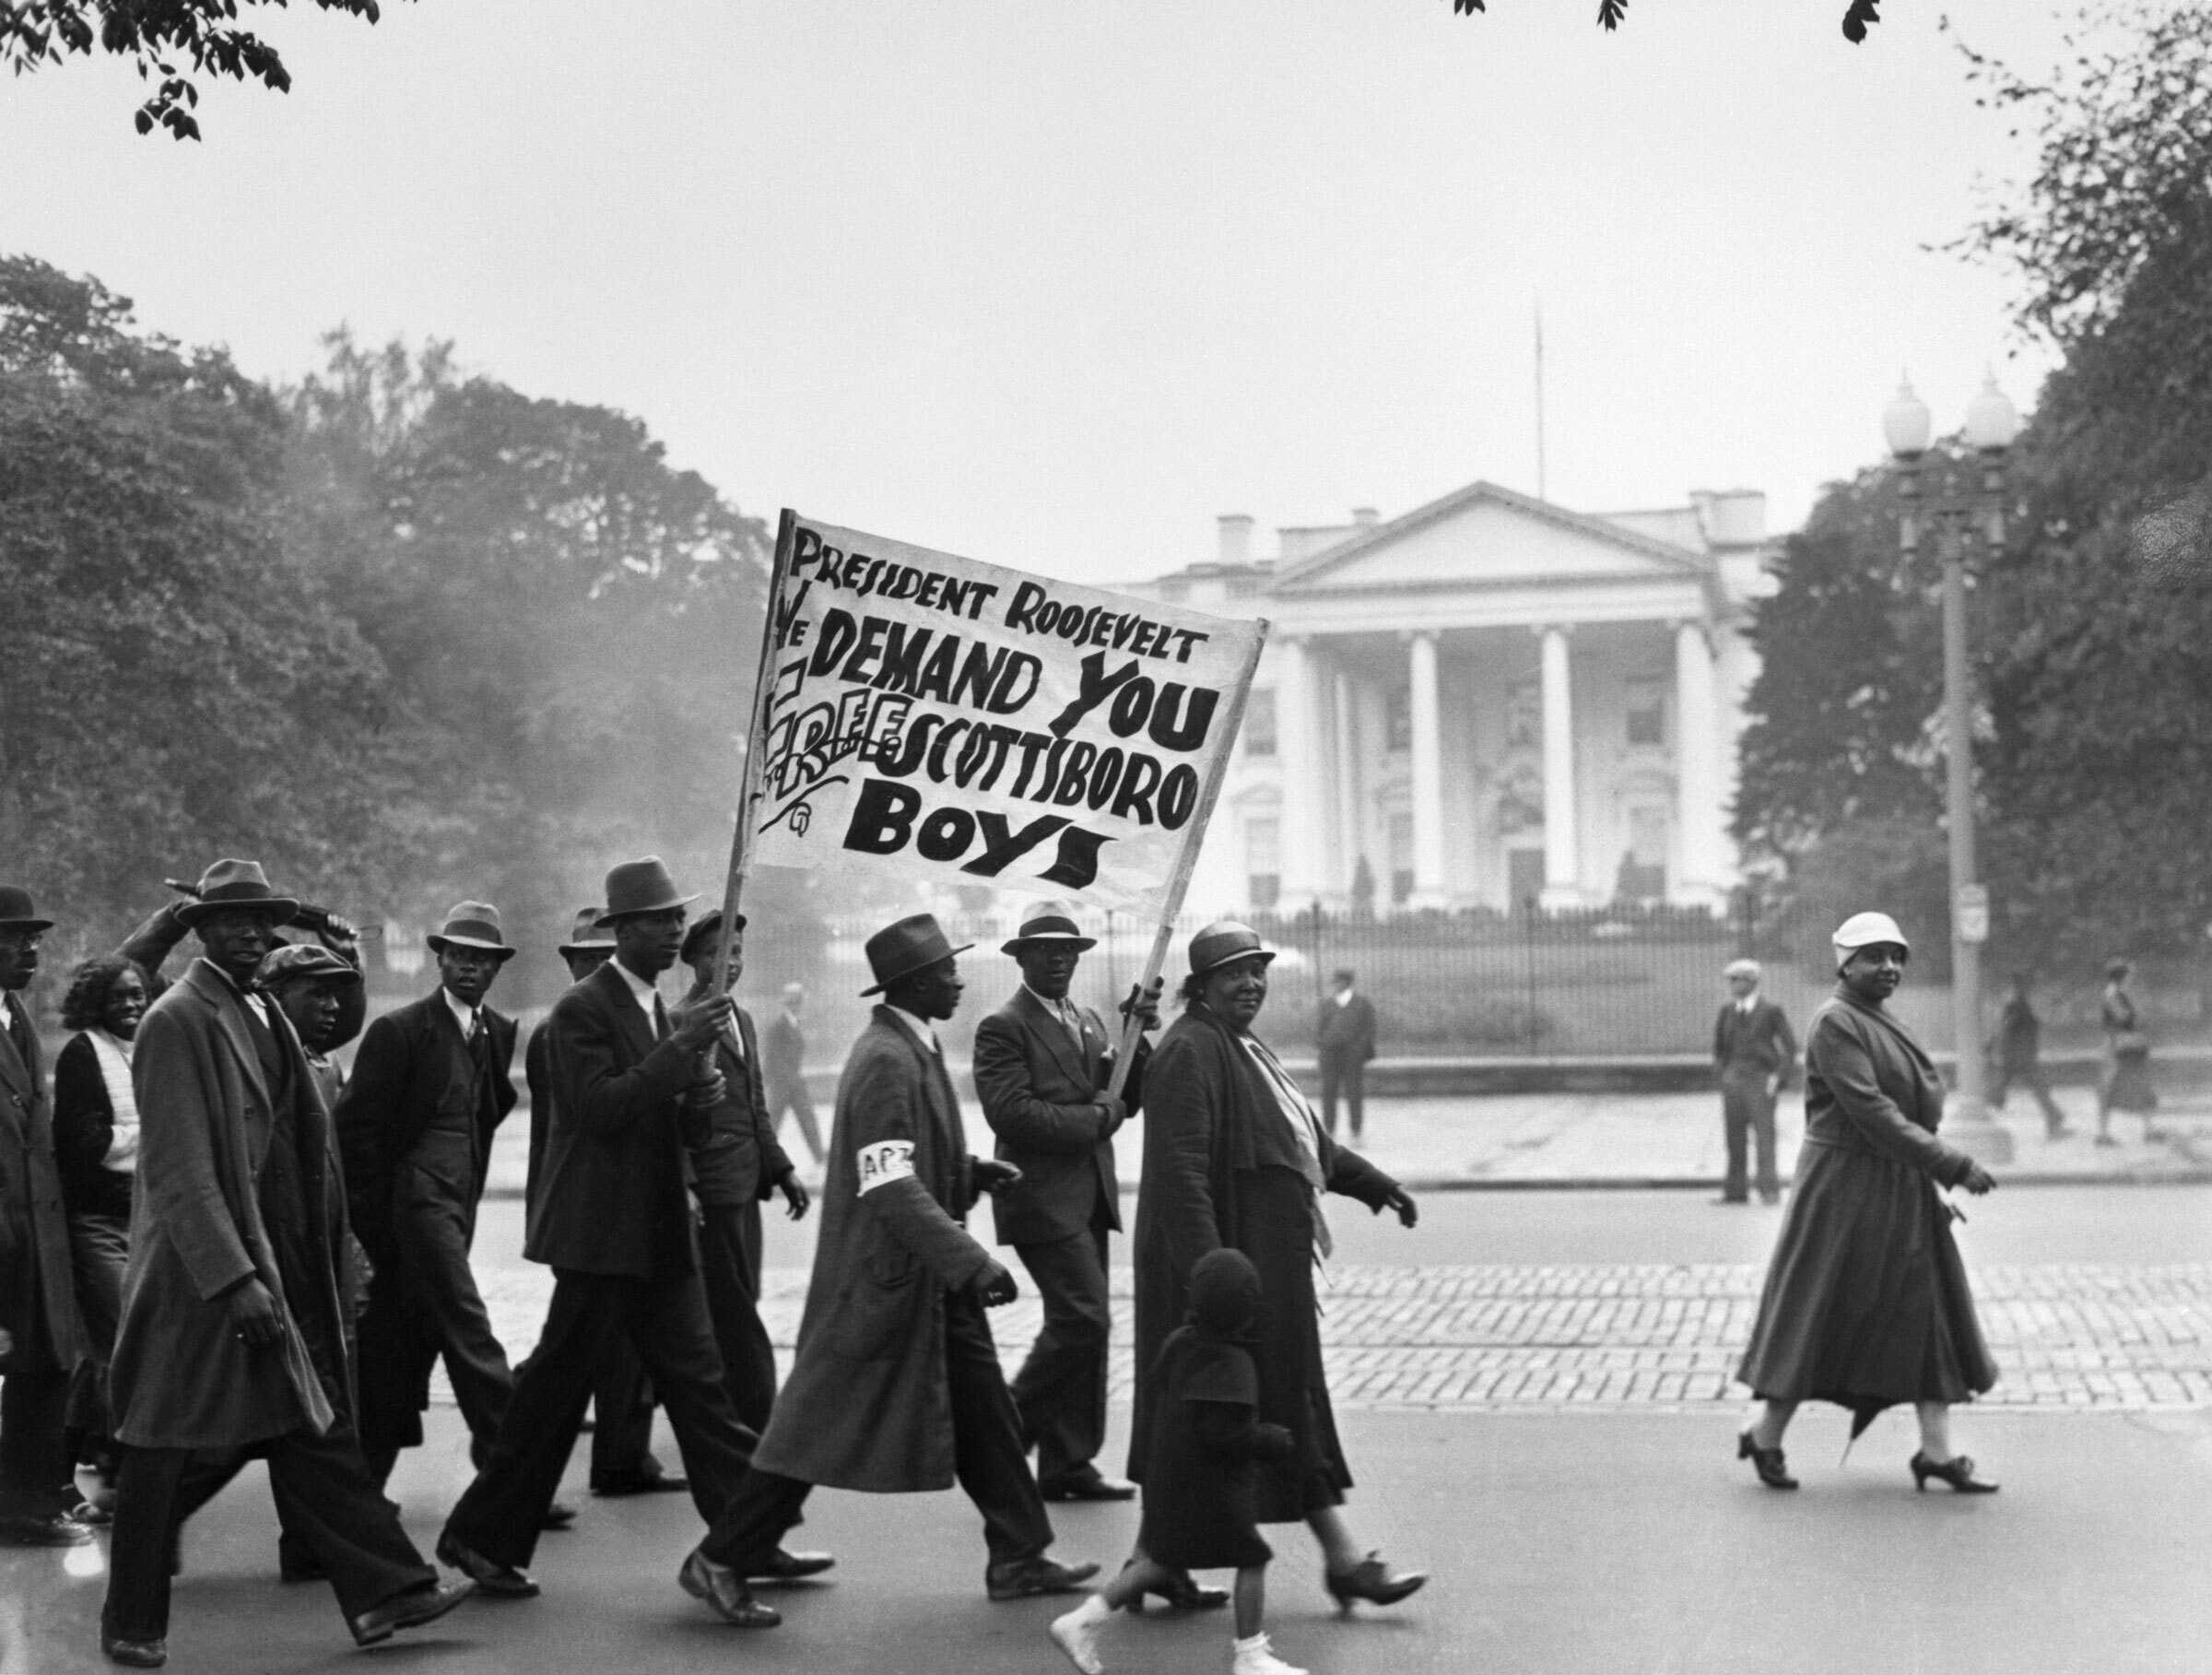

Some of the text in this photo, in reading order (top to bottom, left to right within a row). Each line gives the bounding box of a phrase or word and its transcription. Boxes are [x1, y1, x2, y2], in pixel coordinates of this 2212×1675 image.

[776, 579, 1219, 751] WE DEMAND YOU
[790, 526, 1209, 663] PRESIDENT ROOSEVELT
[763, 656, 1198, 830] FREE SCOTTSBORO
[842, 777, 1119, 890] BOYS
